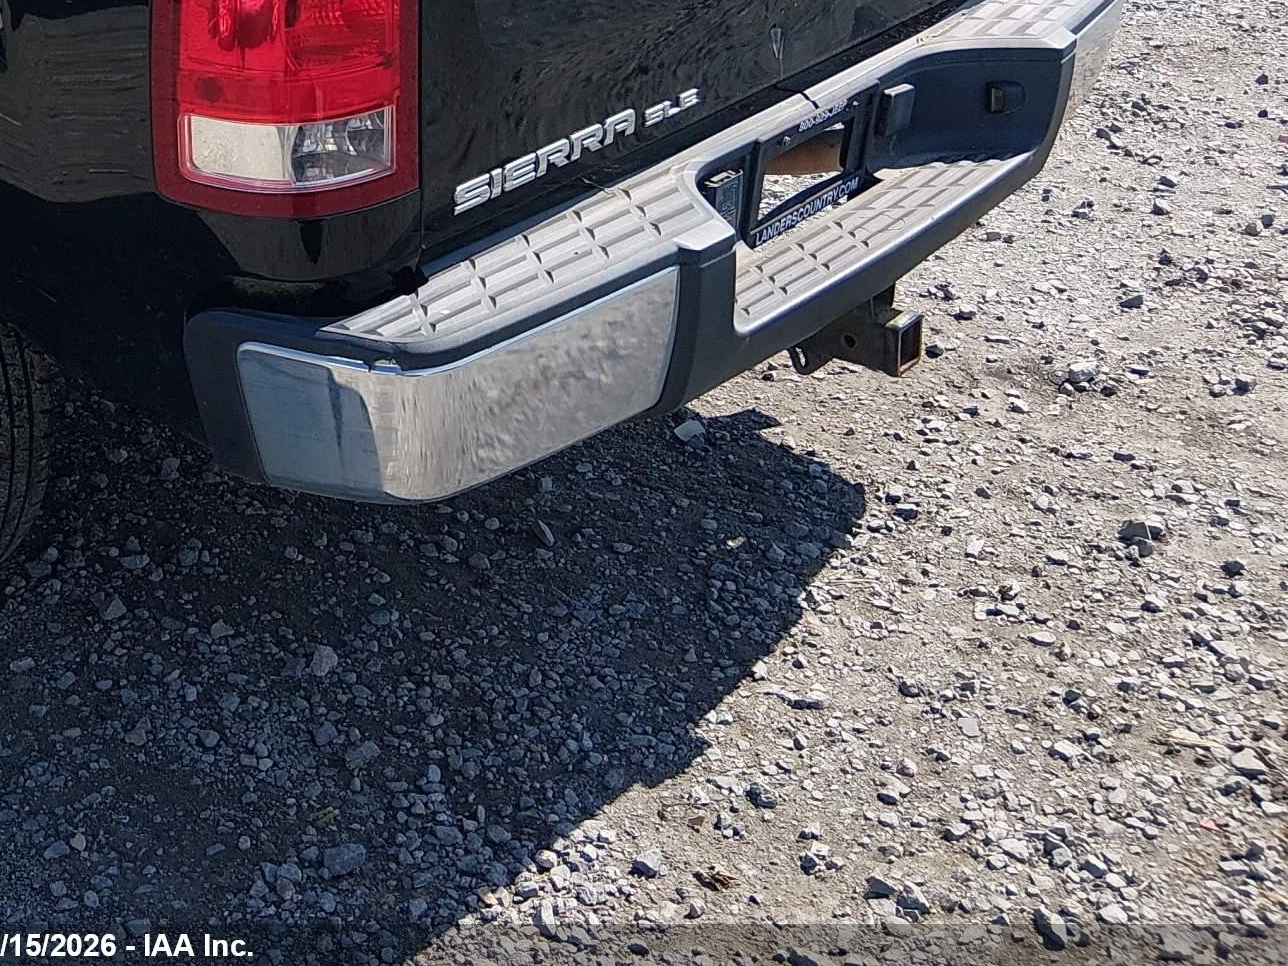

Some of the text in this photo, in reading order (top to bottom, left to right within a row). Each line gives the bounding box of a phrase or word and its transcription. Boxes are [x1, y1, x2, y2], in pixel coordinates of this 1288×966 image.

[453, 87, 701, 216] SIERRA SLE
[755, 176, 859, 245] LANDERSCOUNTRY.COM
